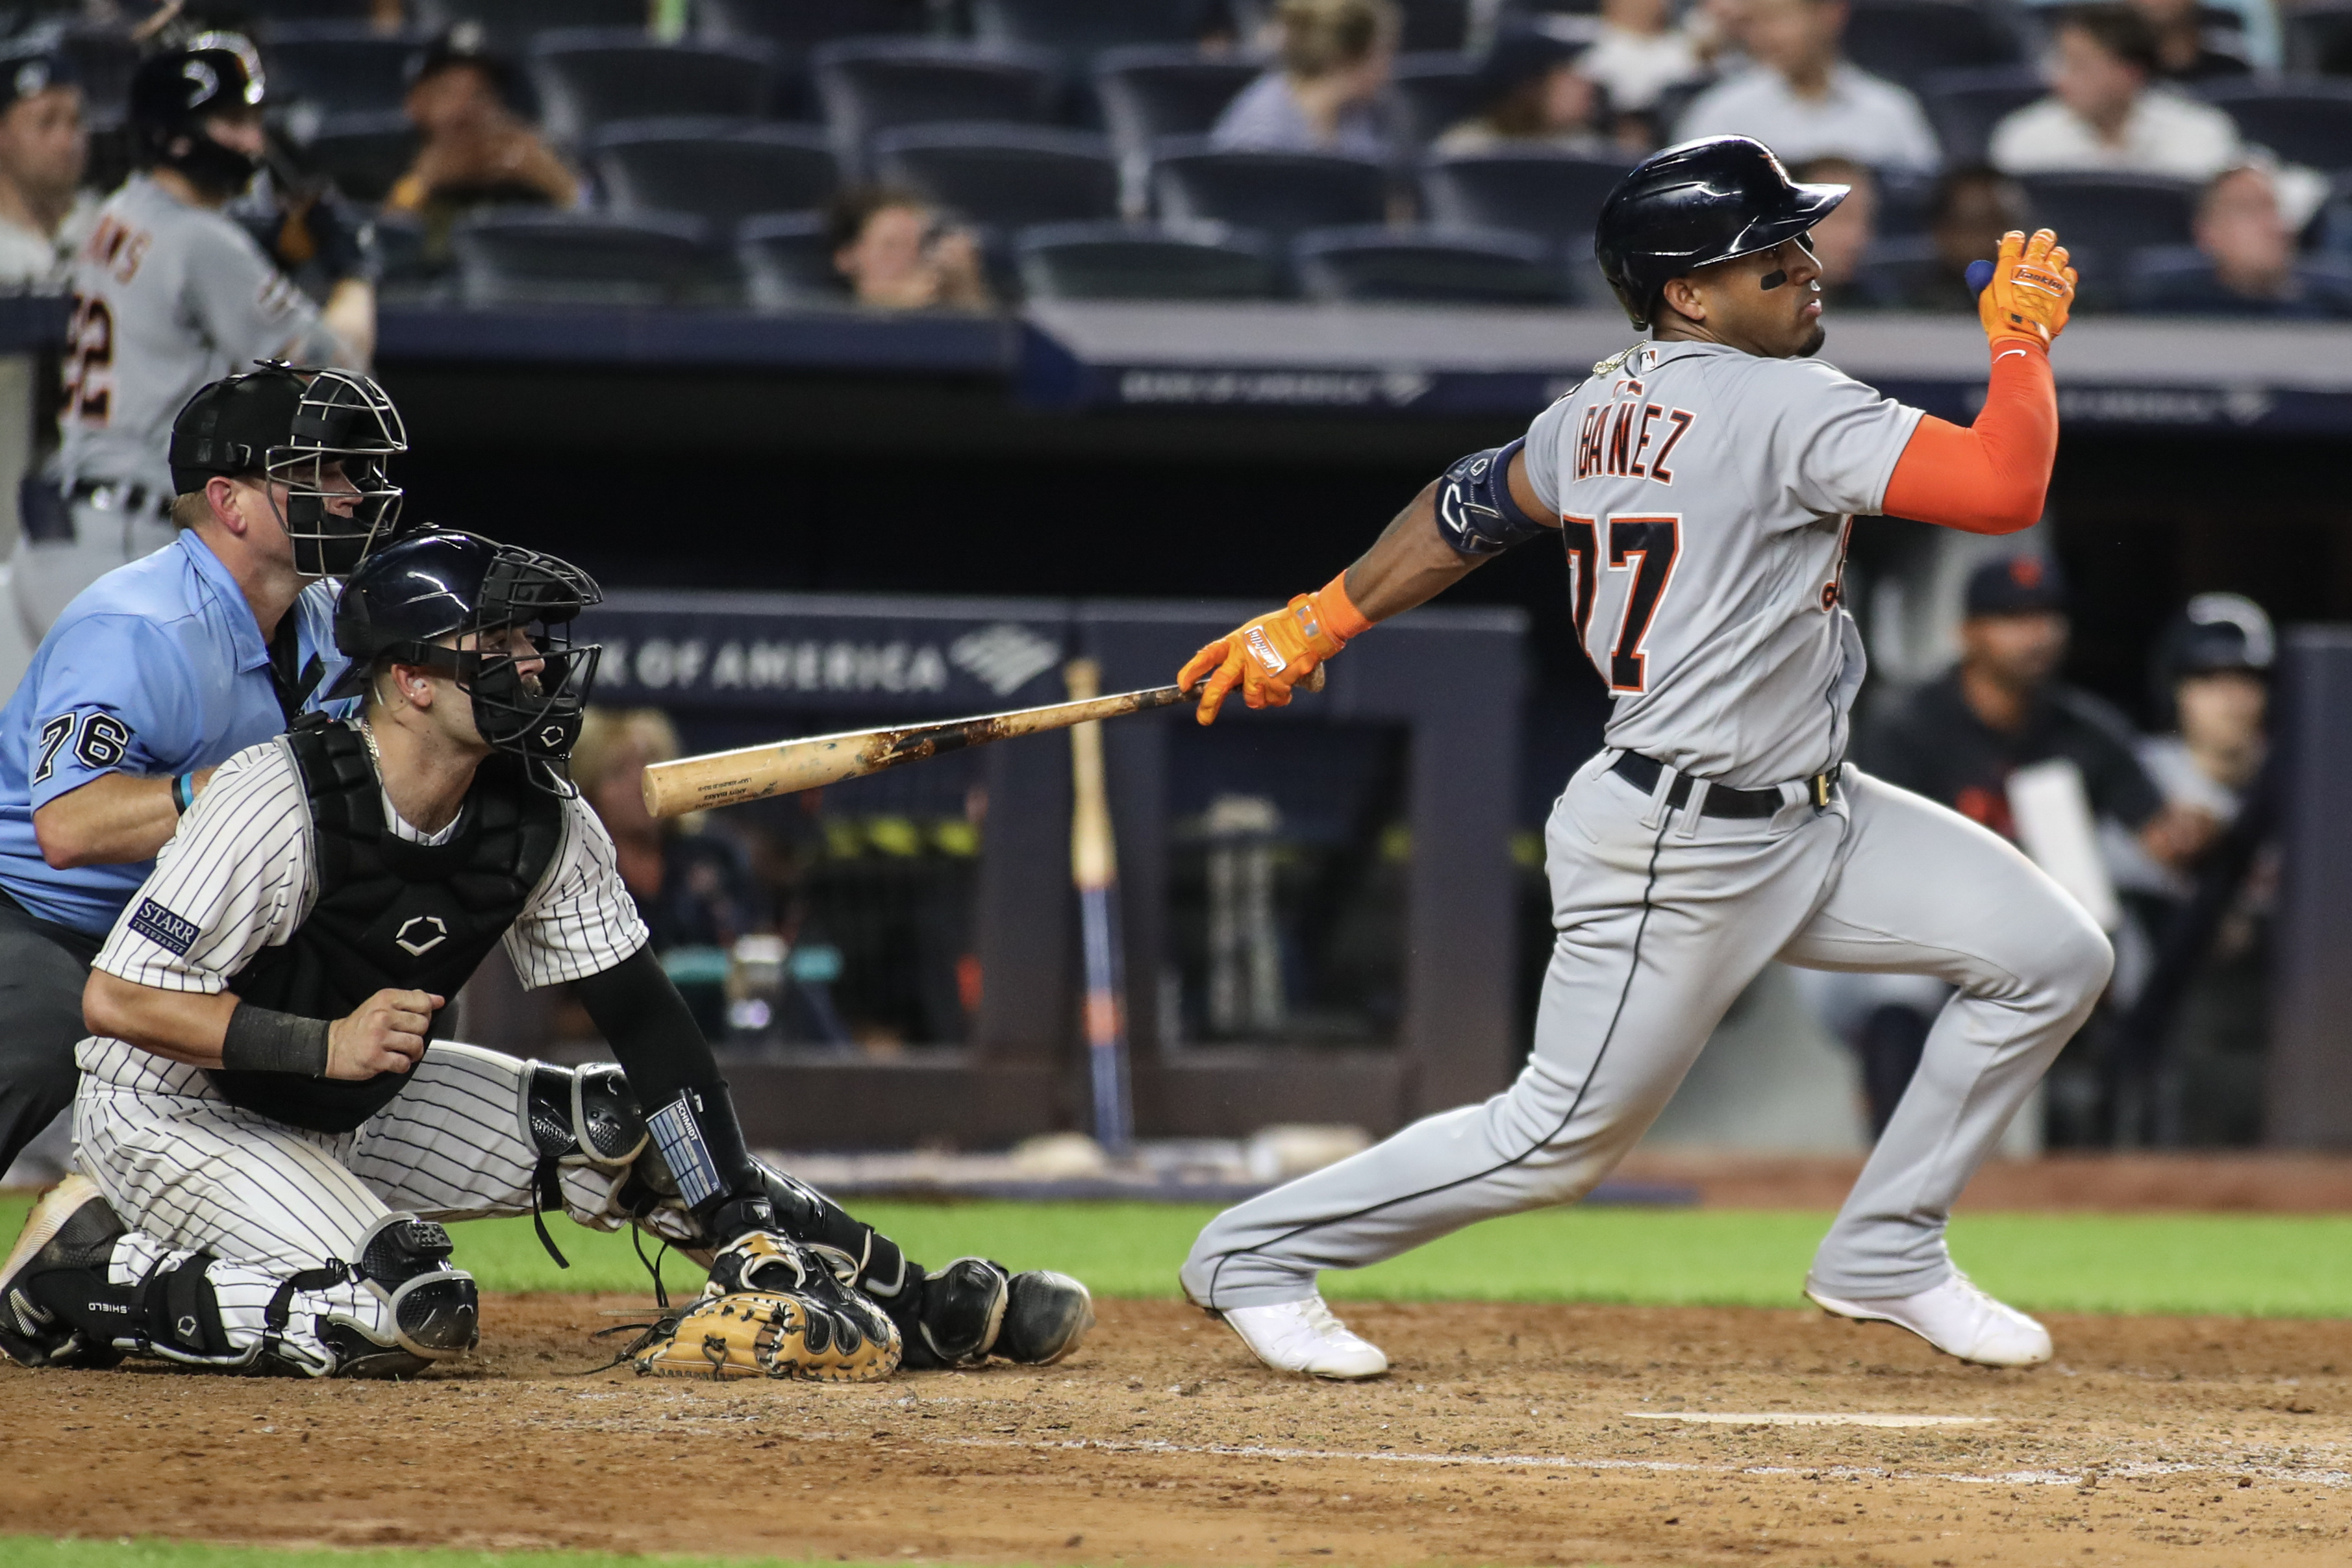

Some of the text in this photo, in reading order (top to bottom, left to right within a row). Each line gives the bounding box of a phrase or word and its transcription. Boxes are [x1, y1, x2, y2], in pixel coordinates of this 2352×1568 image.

[1561, 512, 1684, 697] 77
[636, 639, 707, 689] OF
[714, 640, 949, 692] AMERICA
[32, 711, 130, 787] 76
[133, 921, 184, 954] INSURANCE
[140, 901, 195, 944] STARR
[676, 1101, 699, 1141] SCHMIDT
[88, 1302, 128, 1315] SHIELD
